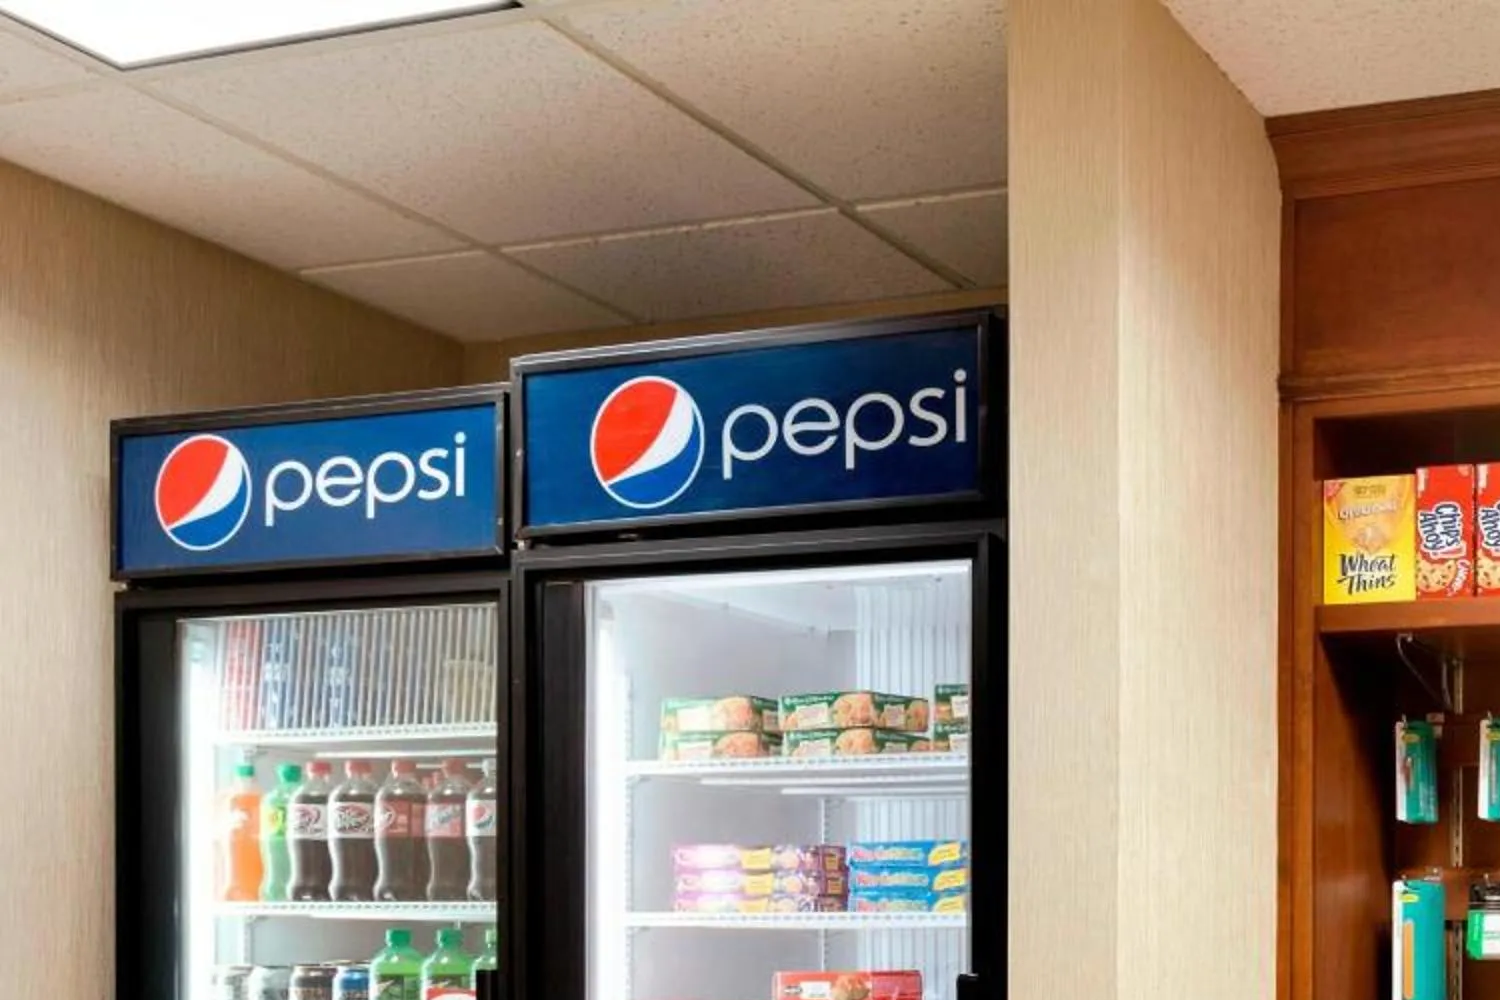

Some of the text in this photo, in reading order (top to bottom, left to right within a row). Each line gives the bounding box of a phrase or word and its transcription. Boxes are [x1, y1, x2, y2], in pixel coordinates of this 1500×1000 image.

[722, 368, 969, 480] pepsi
[265, 431, 467, 526] pepsi
[1337, 572, 1395, 595] Thins
[1338, 553, 1397, 576] Wheat
